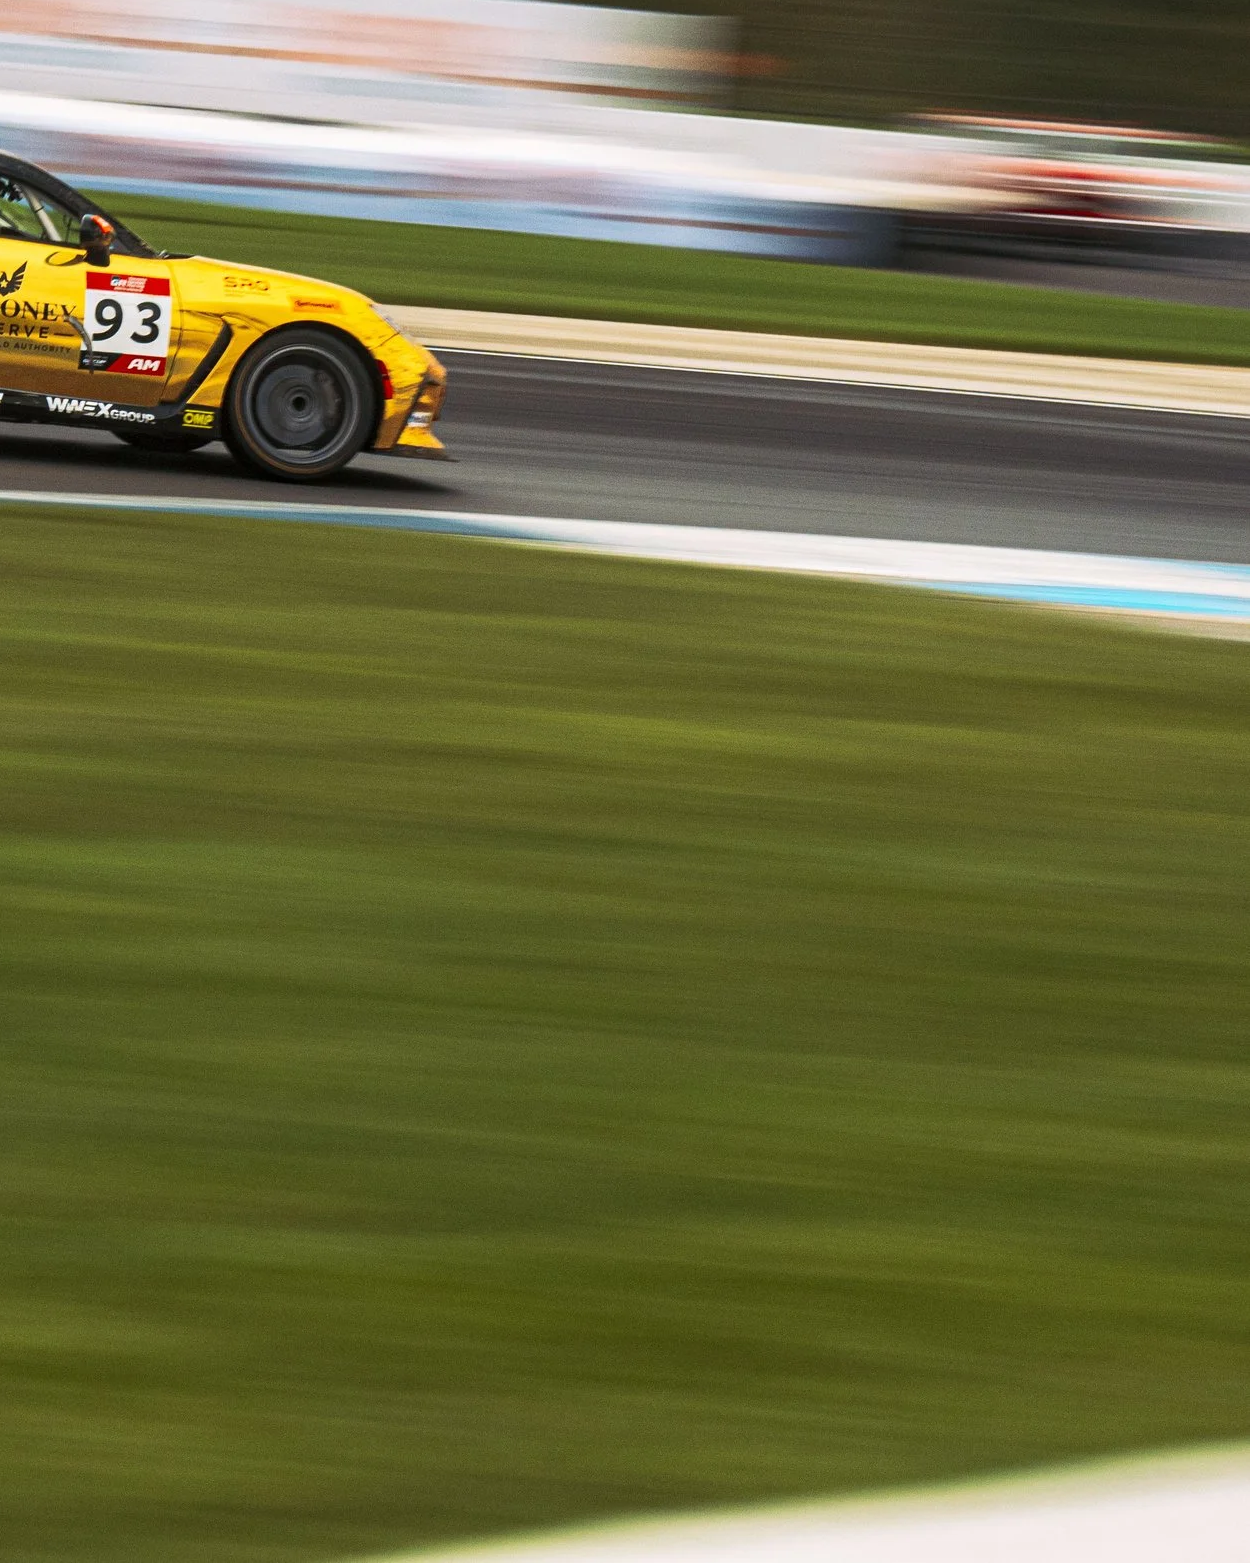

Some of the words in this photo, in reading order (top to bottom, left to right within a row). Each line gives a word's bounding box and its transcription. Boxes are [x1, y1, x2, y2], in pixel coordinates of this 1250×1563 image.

[92, 298, 162, 344] 93
[14, 342, 71, 354] AUTHORITY
[127, 358, 161, 372] AM
[182, 412, 214, 426] OMP
